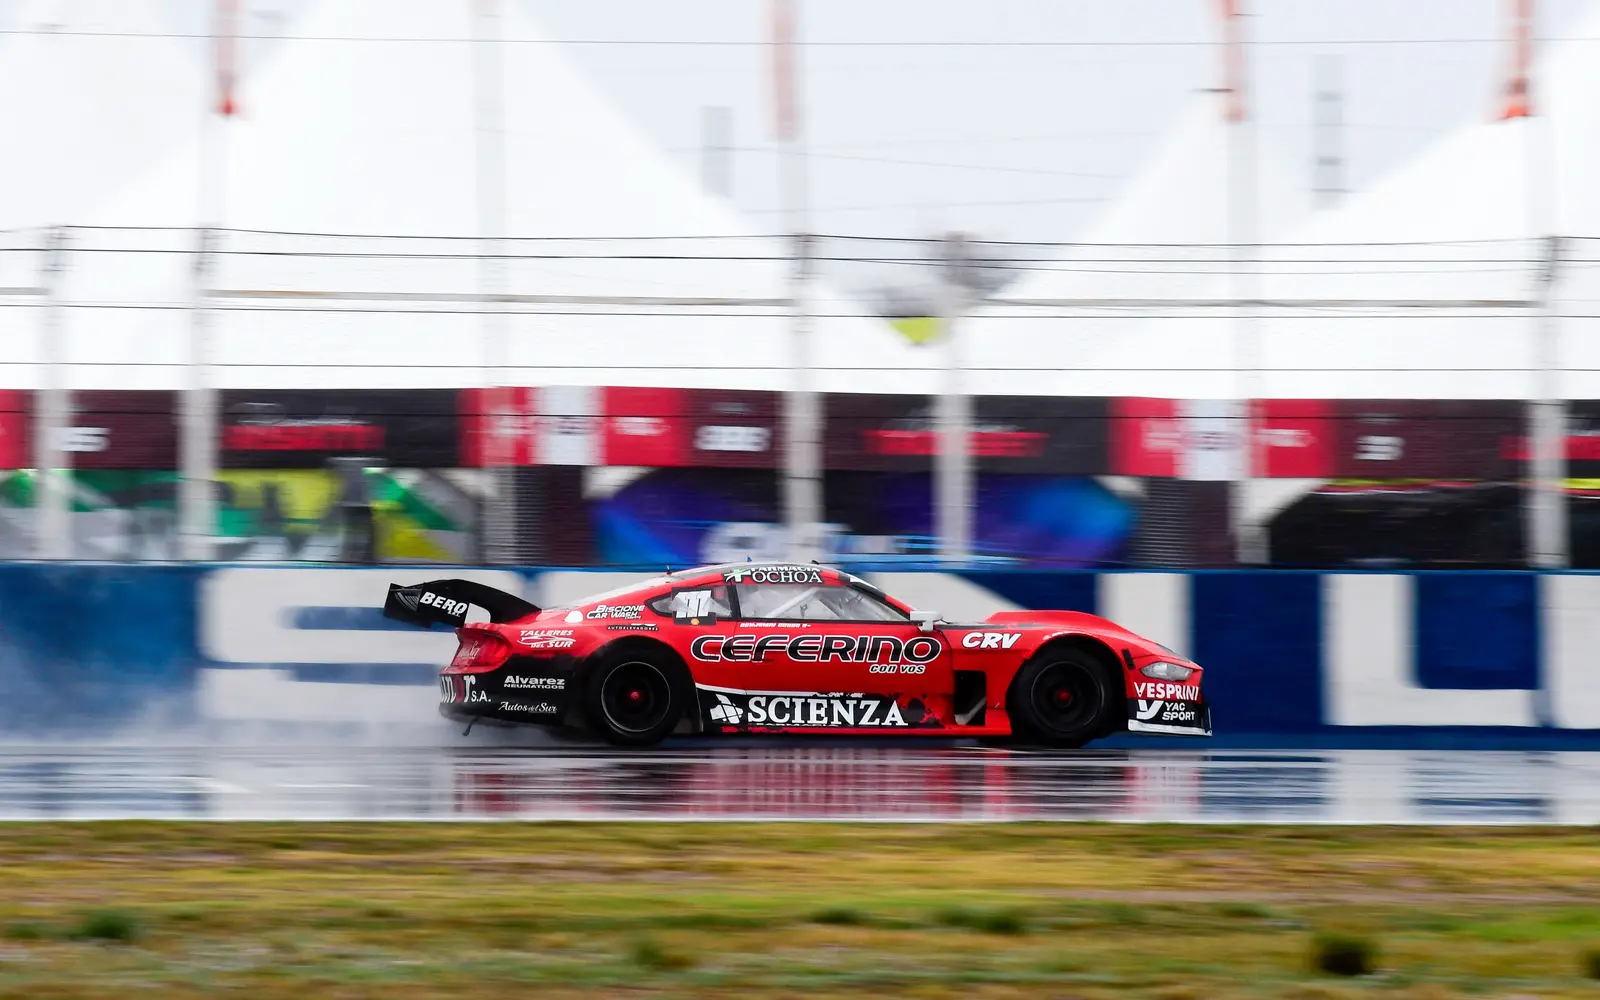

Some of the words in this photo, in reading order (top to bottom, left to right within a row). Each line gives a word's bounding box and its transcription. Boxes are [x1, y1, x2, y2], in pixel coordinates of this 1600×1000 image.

[752, 571, 823, 583] OCHOA
[420, 592, 468, 614] BERO
[595, 605, 646, 613] BISCIONE
[587, 611, 608, 619] CAR
[611, 611, 638, 619] WASH
[962, 632, 1022, 649] CRV
[691, 634, 942, 664] CEFERINO
[504, 675, 565, 685] Alvarez
[471, 690, 492, 703] S.A.
[1134, 682, 1199, 701] VESPRINI
[498, 701, 528, 711] Autos
[539, 702, 557, 712] Sur
[747, 696, 909, 726] SCIENZA
[1165, 702, 1186, 711] YAC
[1162, 712, 1196, 721] SPORT
